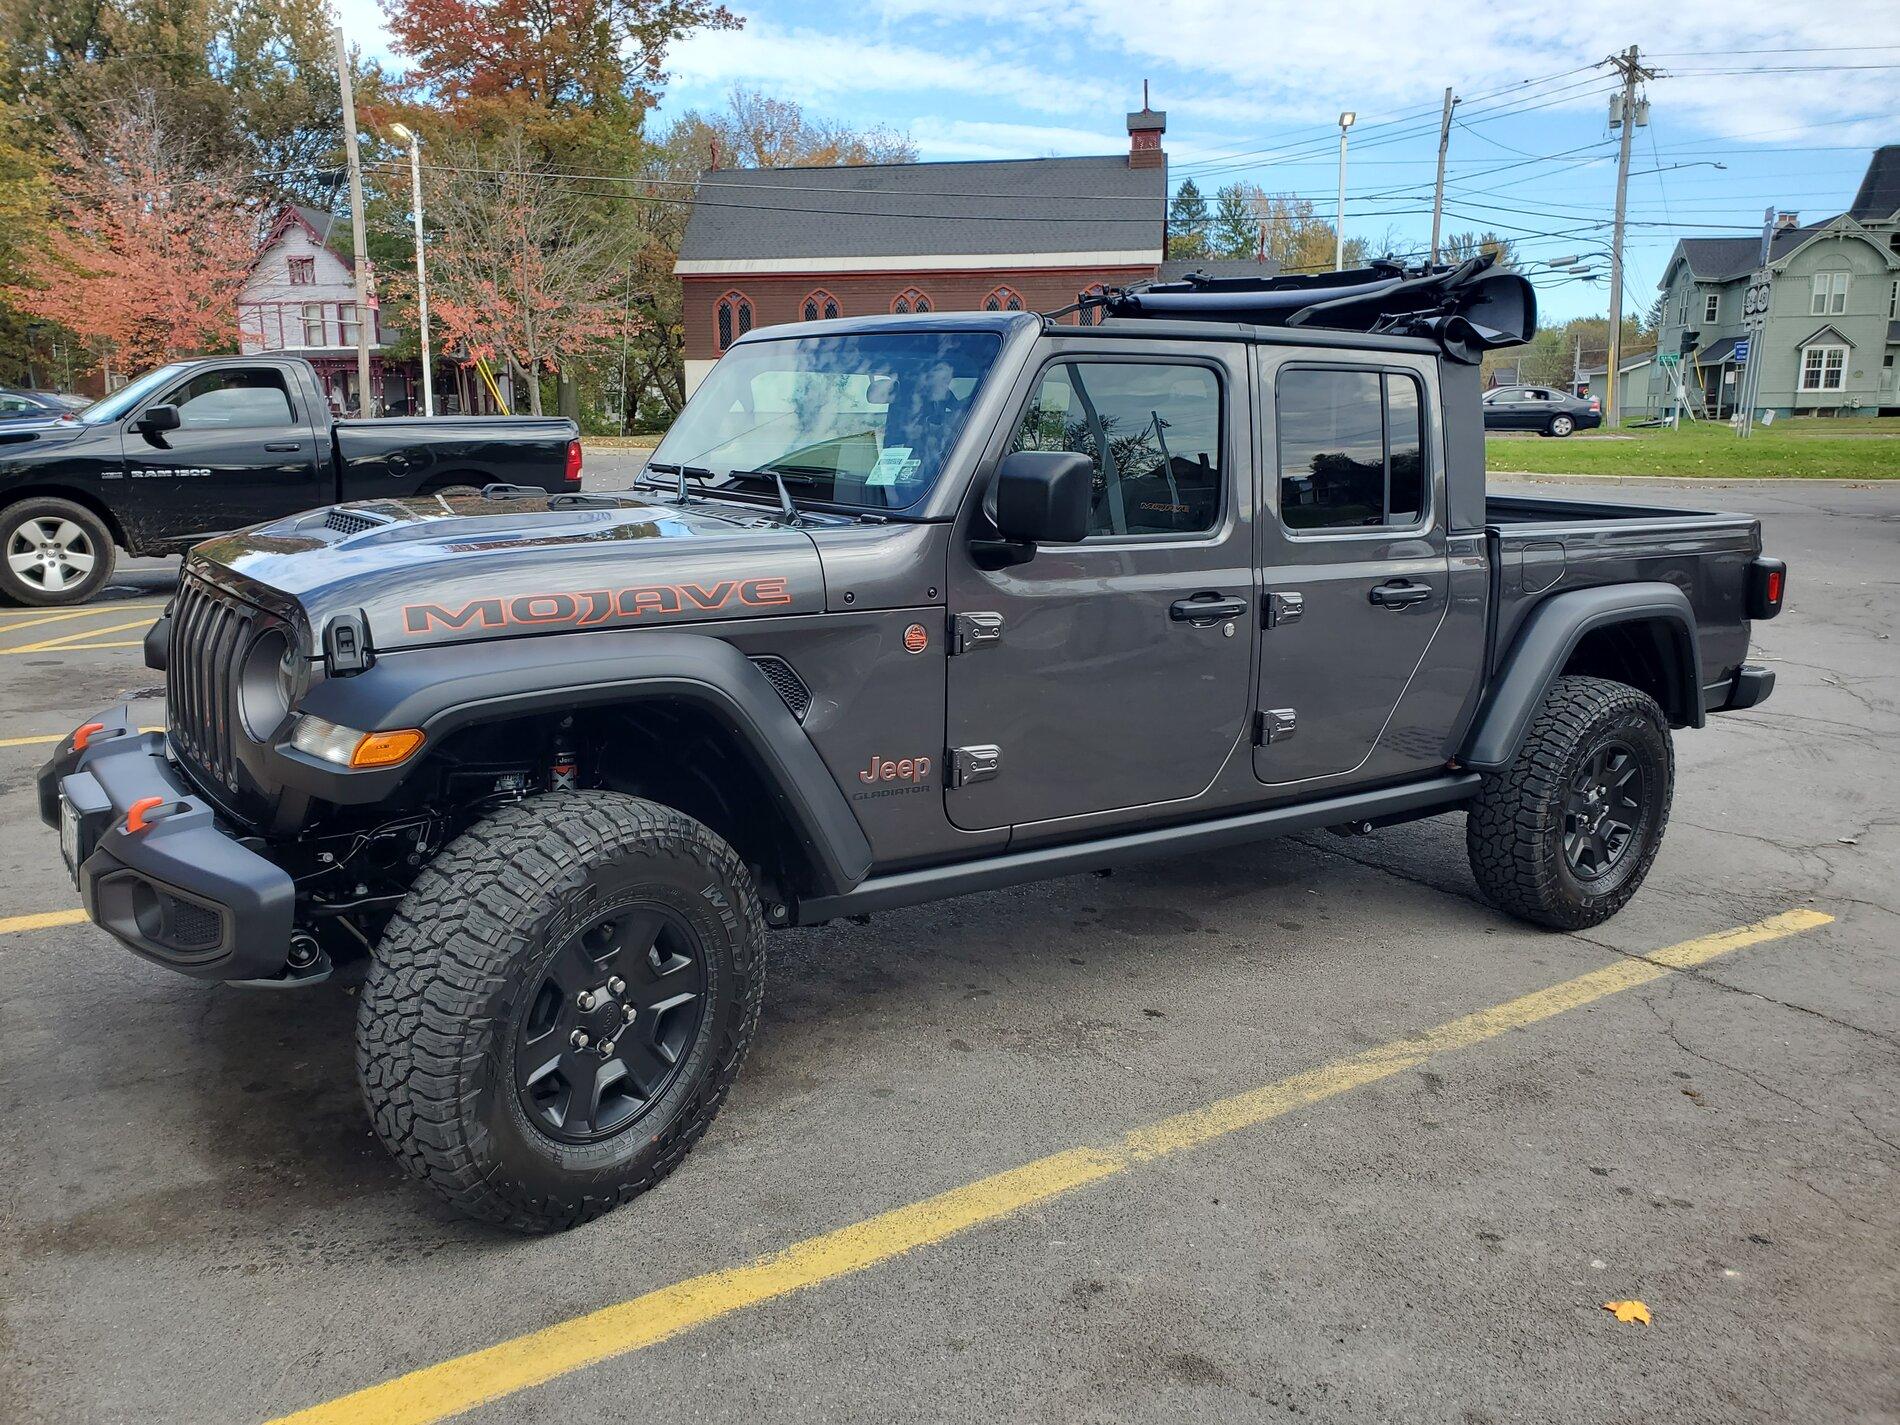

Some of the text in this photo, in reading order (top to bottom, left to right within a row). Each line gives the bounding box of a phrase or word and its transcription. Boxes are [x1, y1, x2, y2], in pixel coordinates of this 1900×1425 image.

[131, 469, 211, 478] RAM 1500
[403, 578, 791, 633] MOJAVE
[859, 756, 932, 783] Jeep
[852, 786, 930, 800] GLADIATOR
